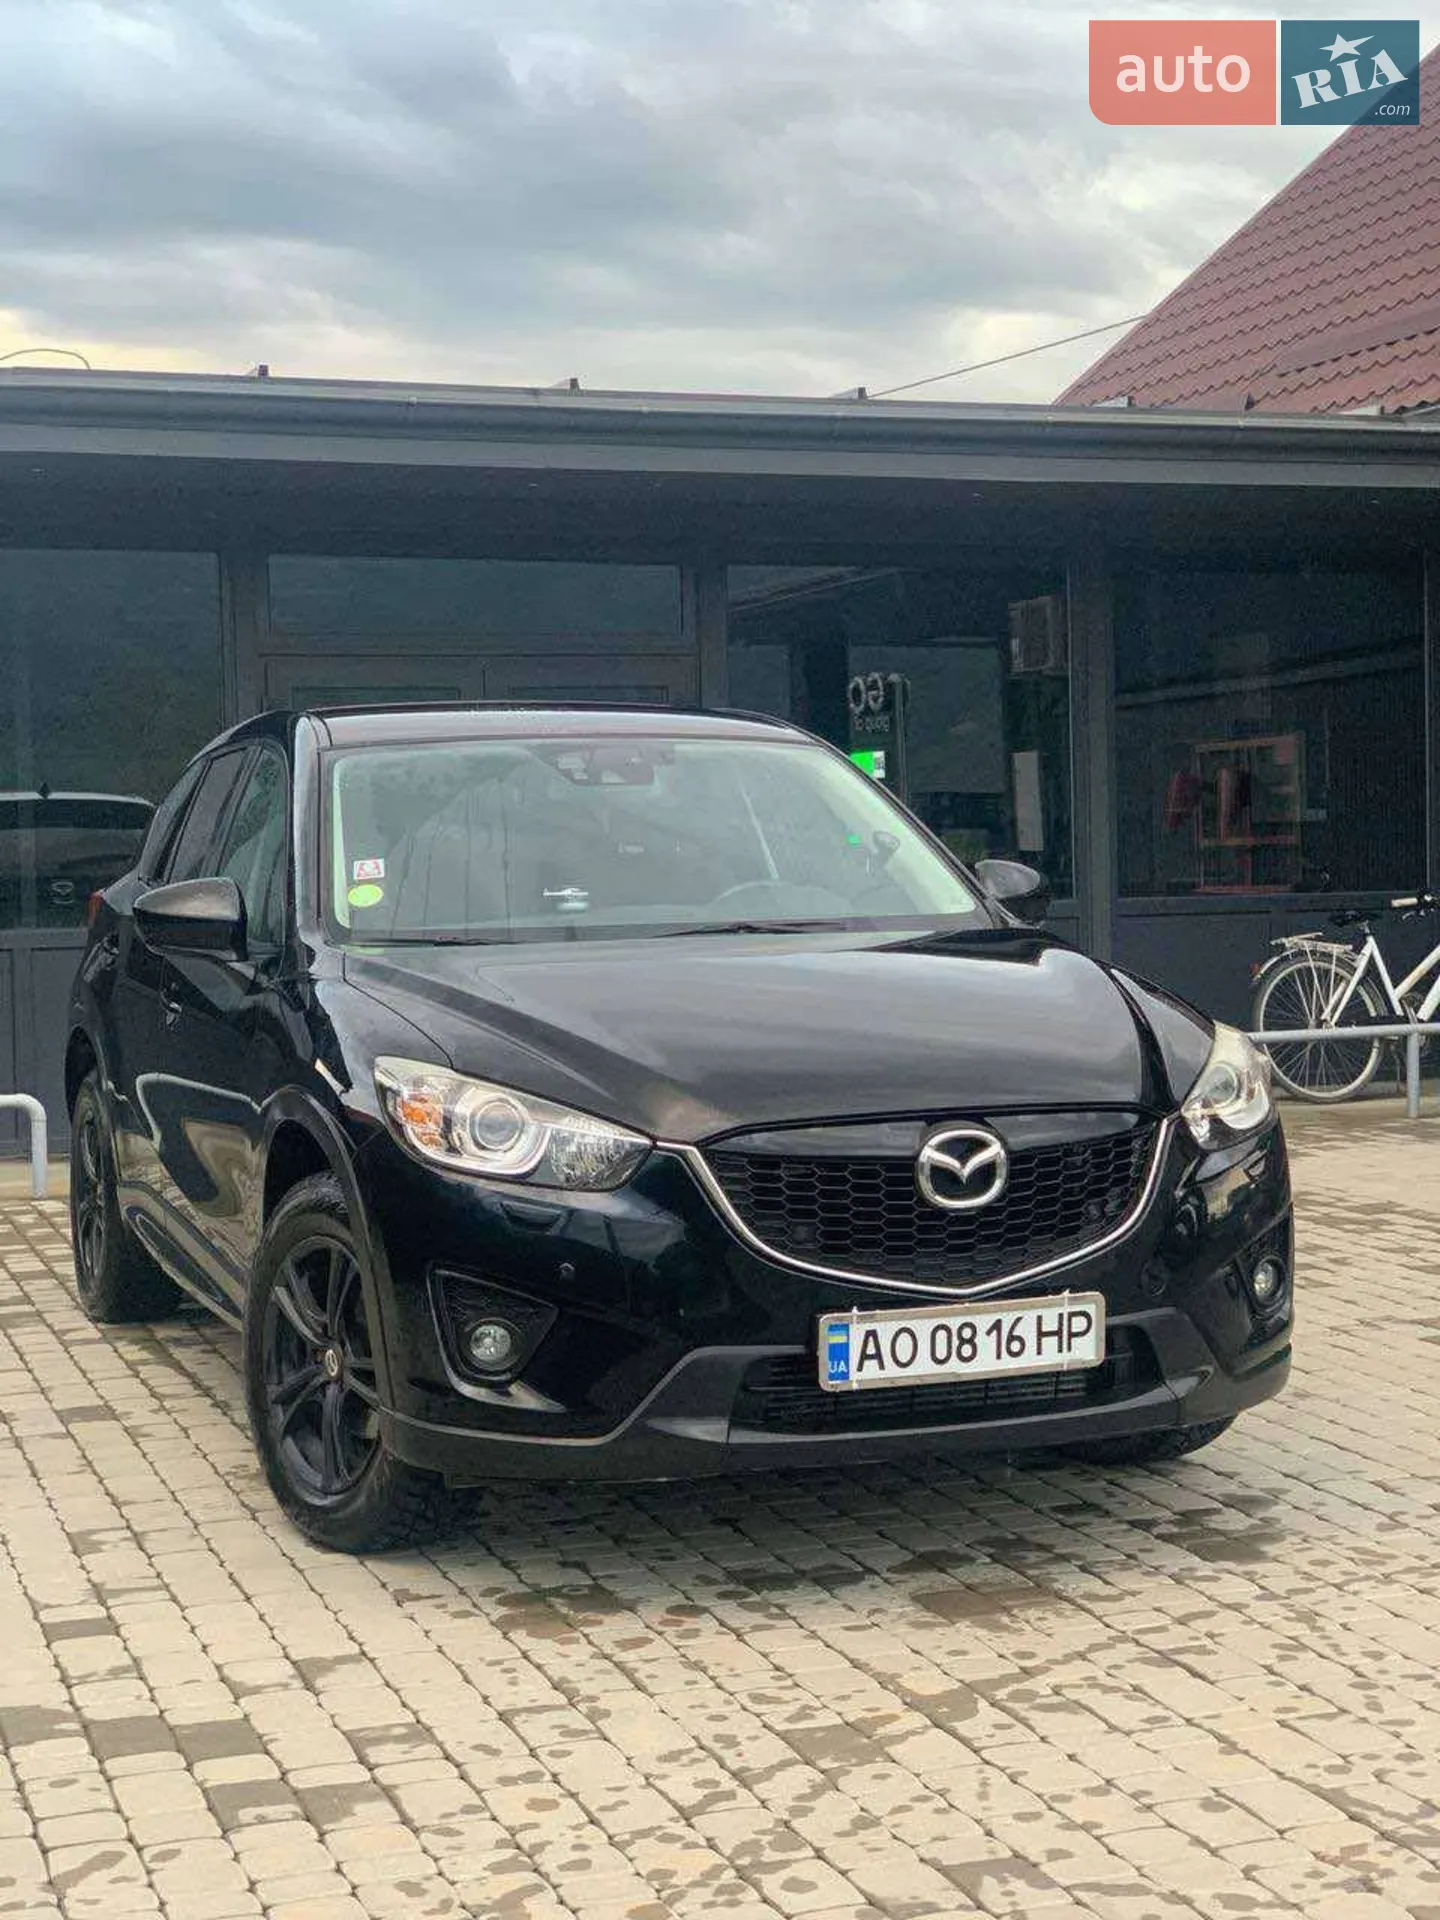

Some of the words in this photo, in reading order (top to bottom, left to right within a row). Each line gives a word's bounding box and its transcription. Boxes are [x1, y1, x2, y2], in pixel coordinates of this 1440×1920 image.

[856, 1326, 919, 1373] AO
[929, 1316, 1027, 1366] 0816
[1036, 1310, 1093, 1356] HP
[828, 1360, 848, 1374] UA
